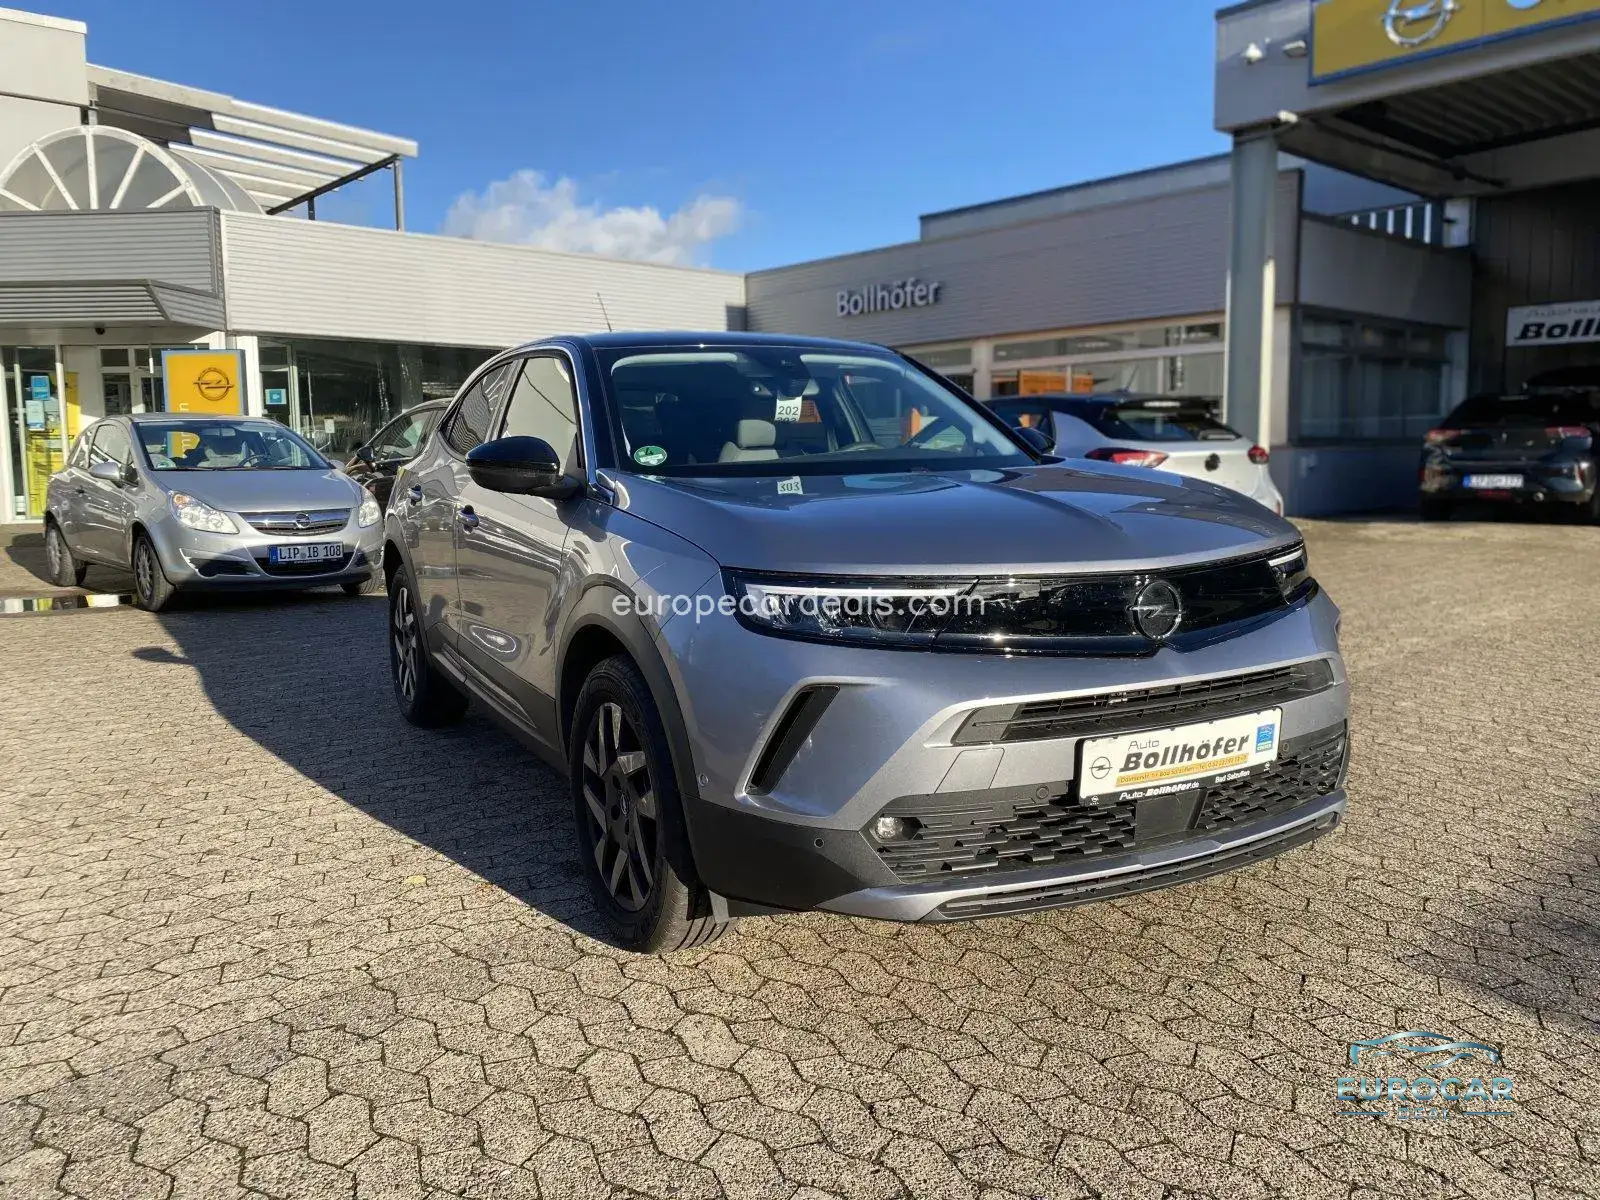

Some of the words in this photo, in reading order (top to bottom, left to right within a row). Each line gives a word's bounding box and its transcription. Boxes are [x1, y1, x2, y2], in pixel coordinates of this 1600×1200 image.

[836, 277, 939, 317] Bollhöfer
[1514, 317, 1600, 341] Boll
[777, 405, 799, 416] 202
[279, 547, 300, 560] LIP
[307, 546, 319, 558] IB
[323, 545, 341, 557] 108
[1119, 733, 1250, 773] Bollhöfer
[1127, 739, 1160, 752] Auto
